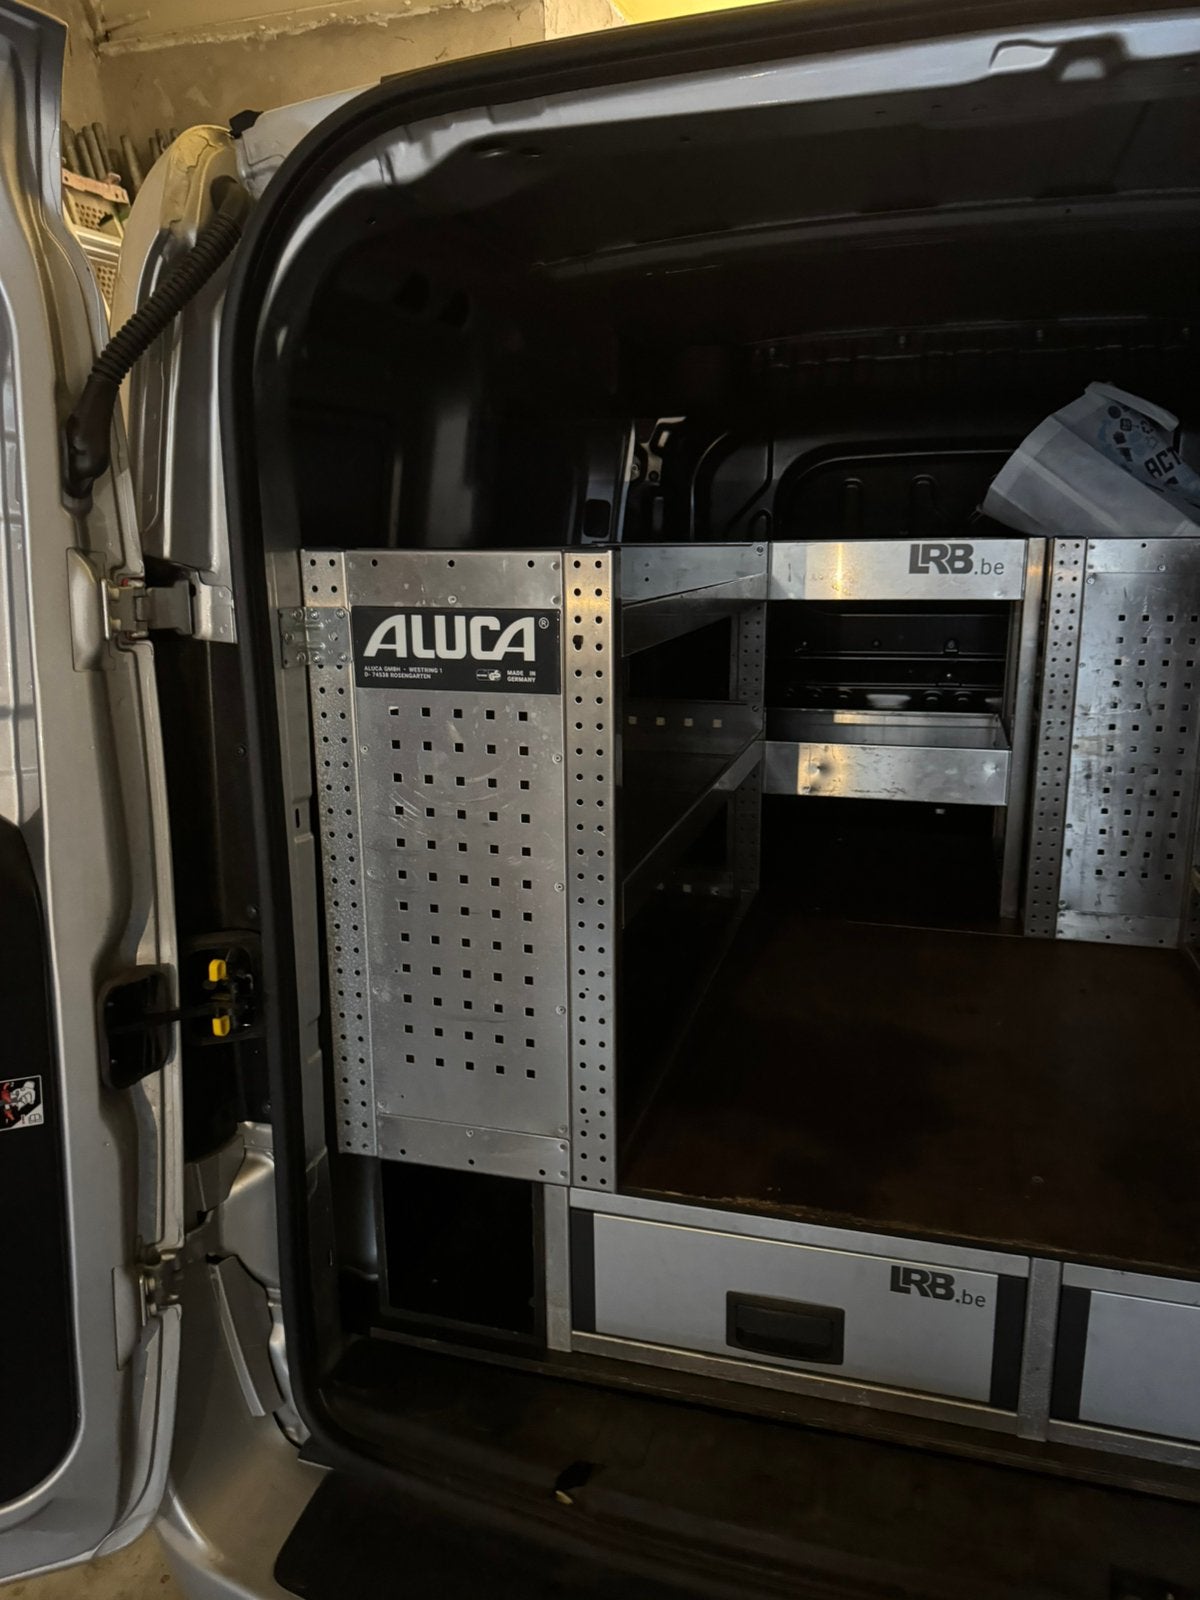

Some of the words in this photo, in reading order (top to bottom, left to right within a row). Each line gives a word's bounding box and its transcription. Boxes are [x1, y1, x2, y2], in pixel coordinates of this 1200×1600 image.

[908, 543, 1005, 575] LRB.be
[363, 614, 536, 662] ALUCA
[890, 1265, 986, 1308] LRB.be
